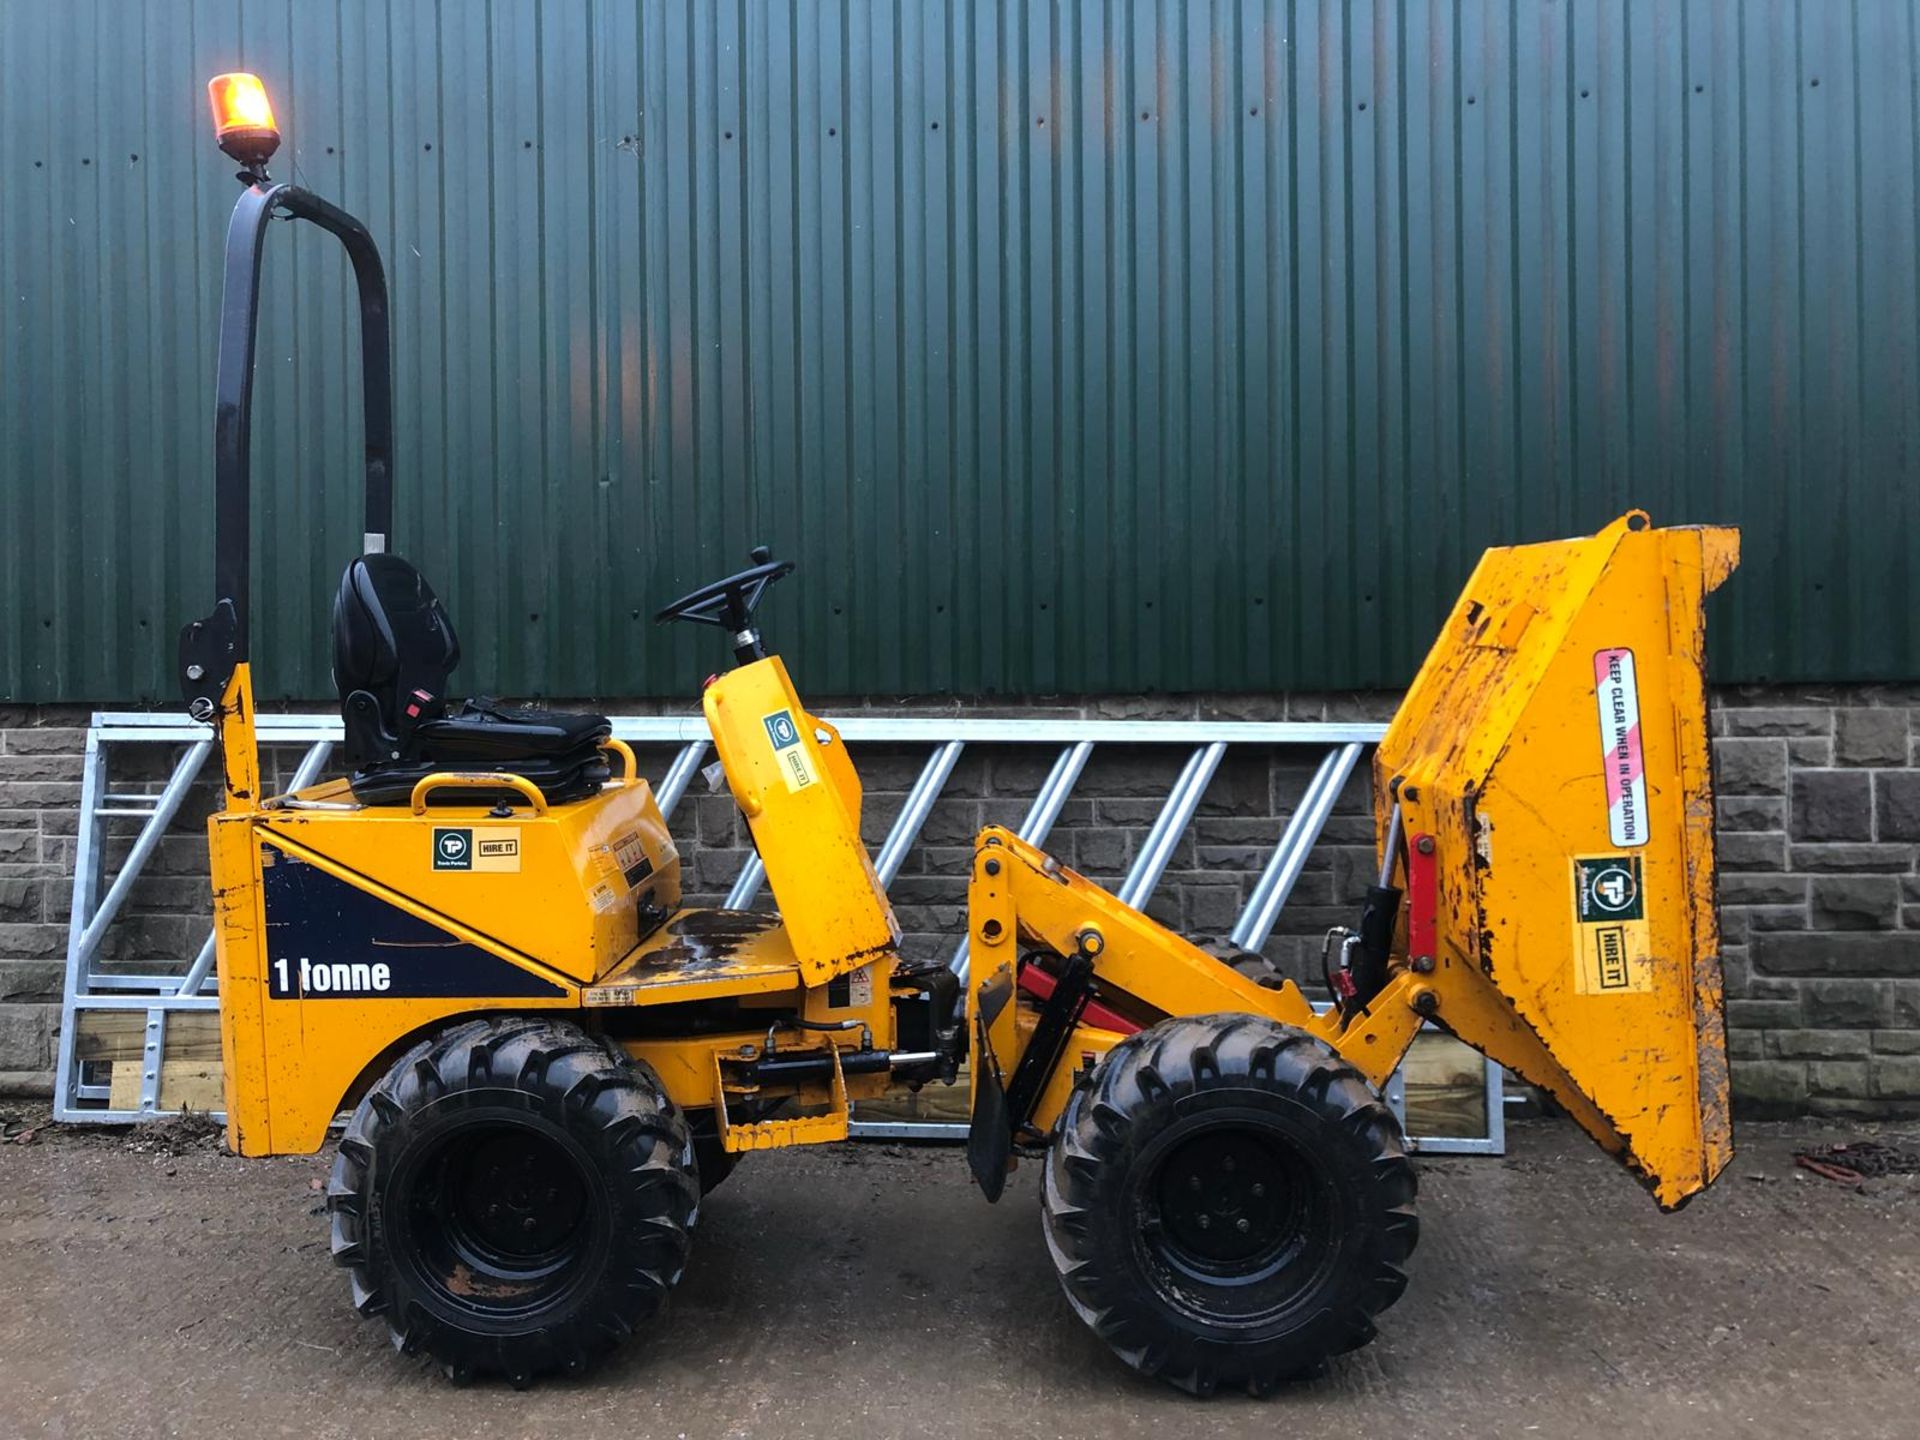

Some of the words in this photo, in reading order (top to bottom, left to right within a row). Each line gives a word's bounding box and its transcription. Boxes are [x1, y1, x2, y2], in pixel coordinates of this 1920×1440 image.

[1608, 655, 1622, 684] KEEP
[1611, 687, 1626, 724] CLEAR
[1615, 726, 1629, 760] WHEN
[1619, 763, 1630, 775] IN
[1620, 778, 1636, 840] OPERATION
[444, 840, 463, 854] TP
[483, 844, 503, 853] HIRE
[505, 843, 514, 852] IT
[1602, 876, 1624, 905] TP
[1603, 933, 1619, 965] HIRE
[274, 958, 289, 992] 1
[300, 957, 391, 992] tonne
[1607, 969, 1620, 981] IT
